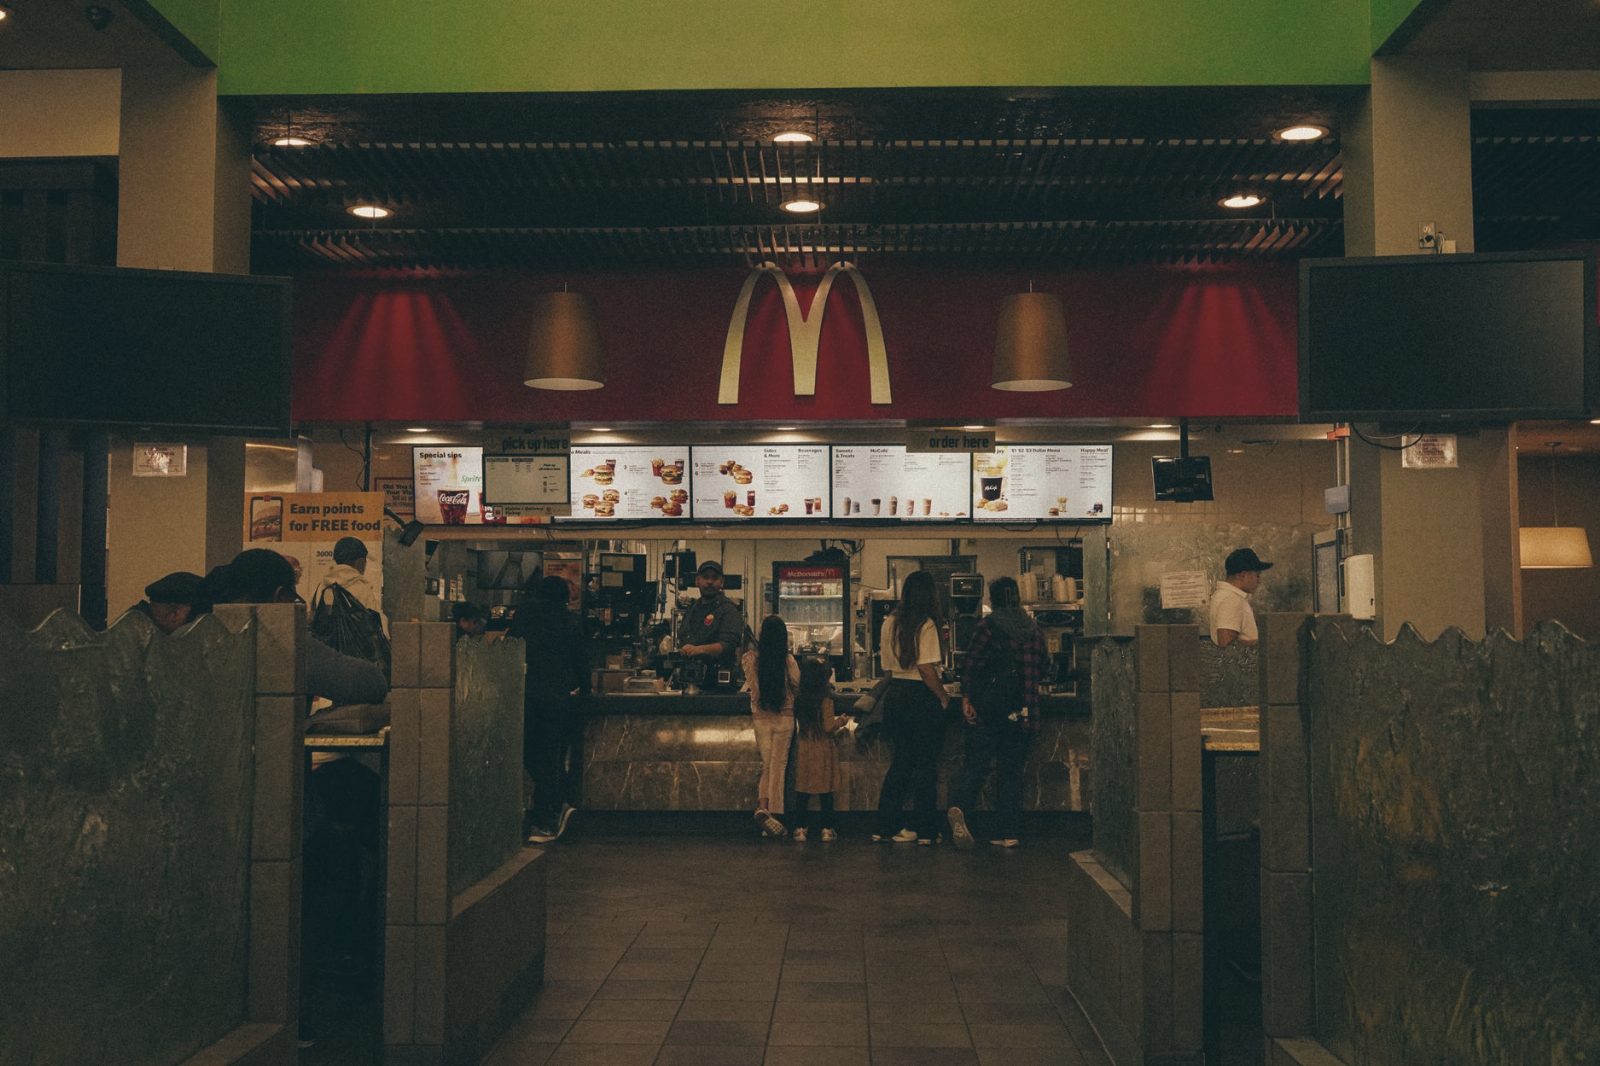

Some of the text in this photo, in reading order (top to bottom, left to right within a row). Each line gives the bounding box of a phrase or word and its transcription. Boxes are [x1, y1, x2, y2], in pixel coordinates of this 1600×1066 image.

[502, 436, 568, 452] pick up here
[929, 435, 989, 448] order here
[419, 451, 462, 459] Special sips
[461, 474, 481, 483] Sprite
[290, 503, 364, 516] Earn points
[289, 519, 381, 531] for FREE food
